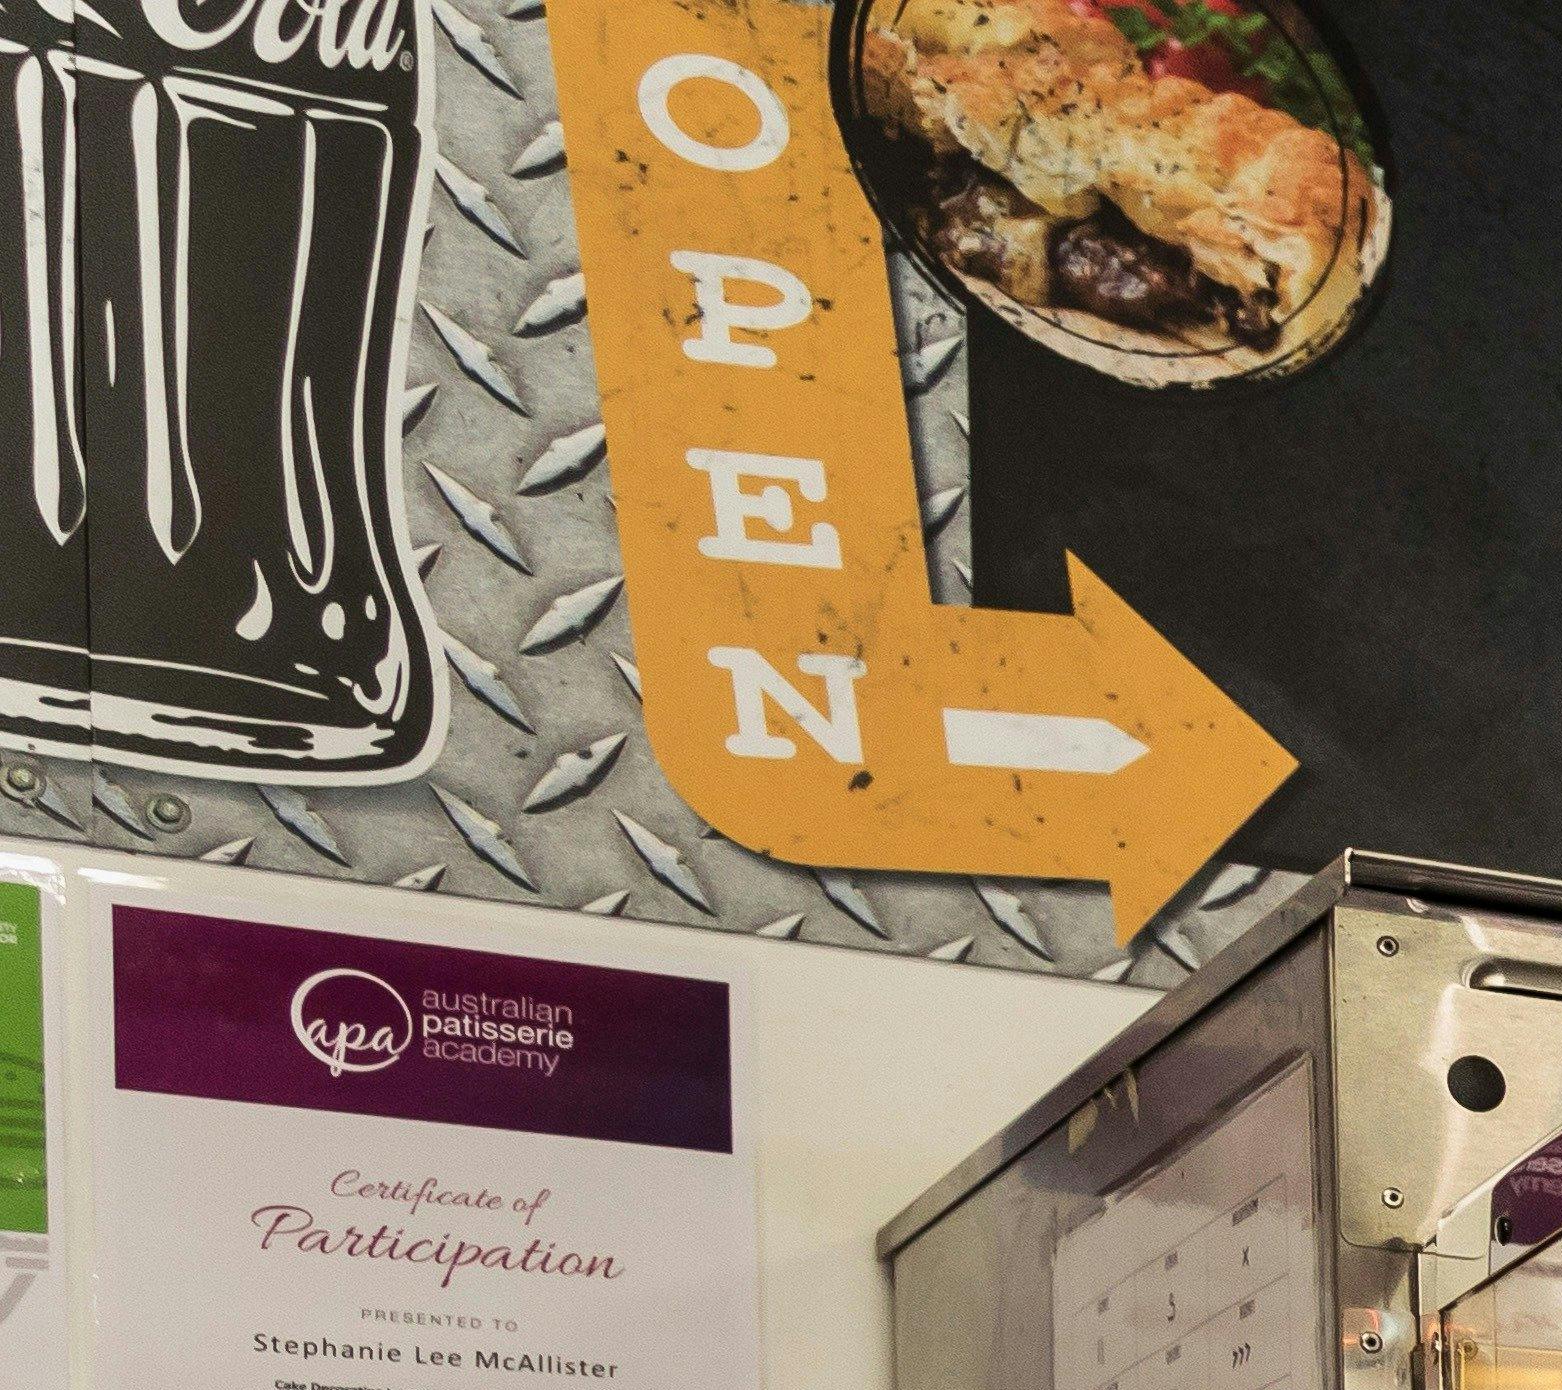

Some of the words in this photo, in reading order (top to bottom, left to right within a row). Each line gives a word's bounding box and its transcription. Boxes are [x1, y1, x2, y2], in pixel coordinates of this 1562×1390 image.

[636, 52, 868, 766] OPEN
[421, 988, 575, 1027] australian
[421, 1012, 575, 1050] patisserie
[303, 1017, 399, 1077] apa
[421, 1038, 560, 1077] academy
[330, 1168, 506, 1215] Certificate
[511, 1187, 552, 1227] of
[249, 1203, 625, 1289] Participation
[359, 1306, 484, 1331] PRESENTED
[493, 1318, 519, 1333] TO
[252, 1332, 402, 1364] Stephanie
[414, 1345, 463, 1369] Lee
[474, 1349, 620, 1379] McAllister
